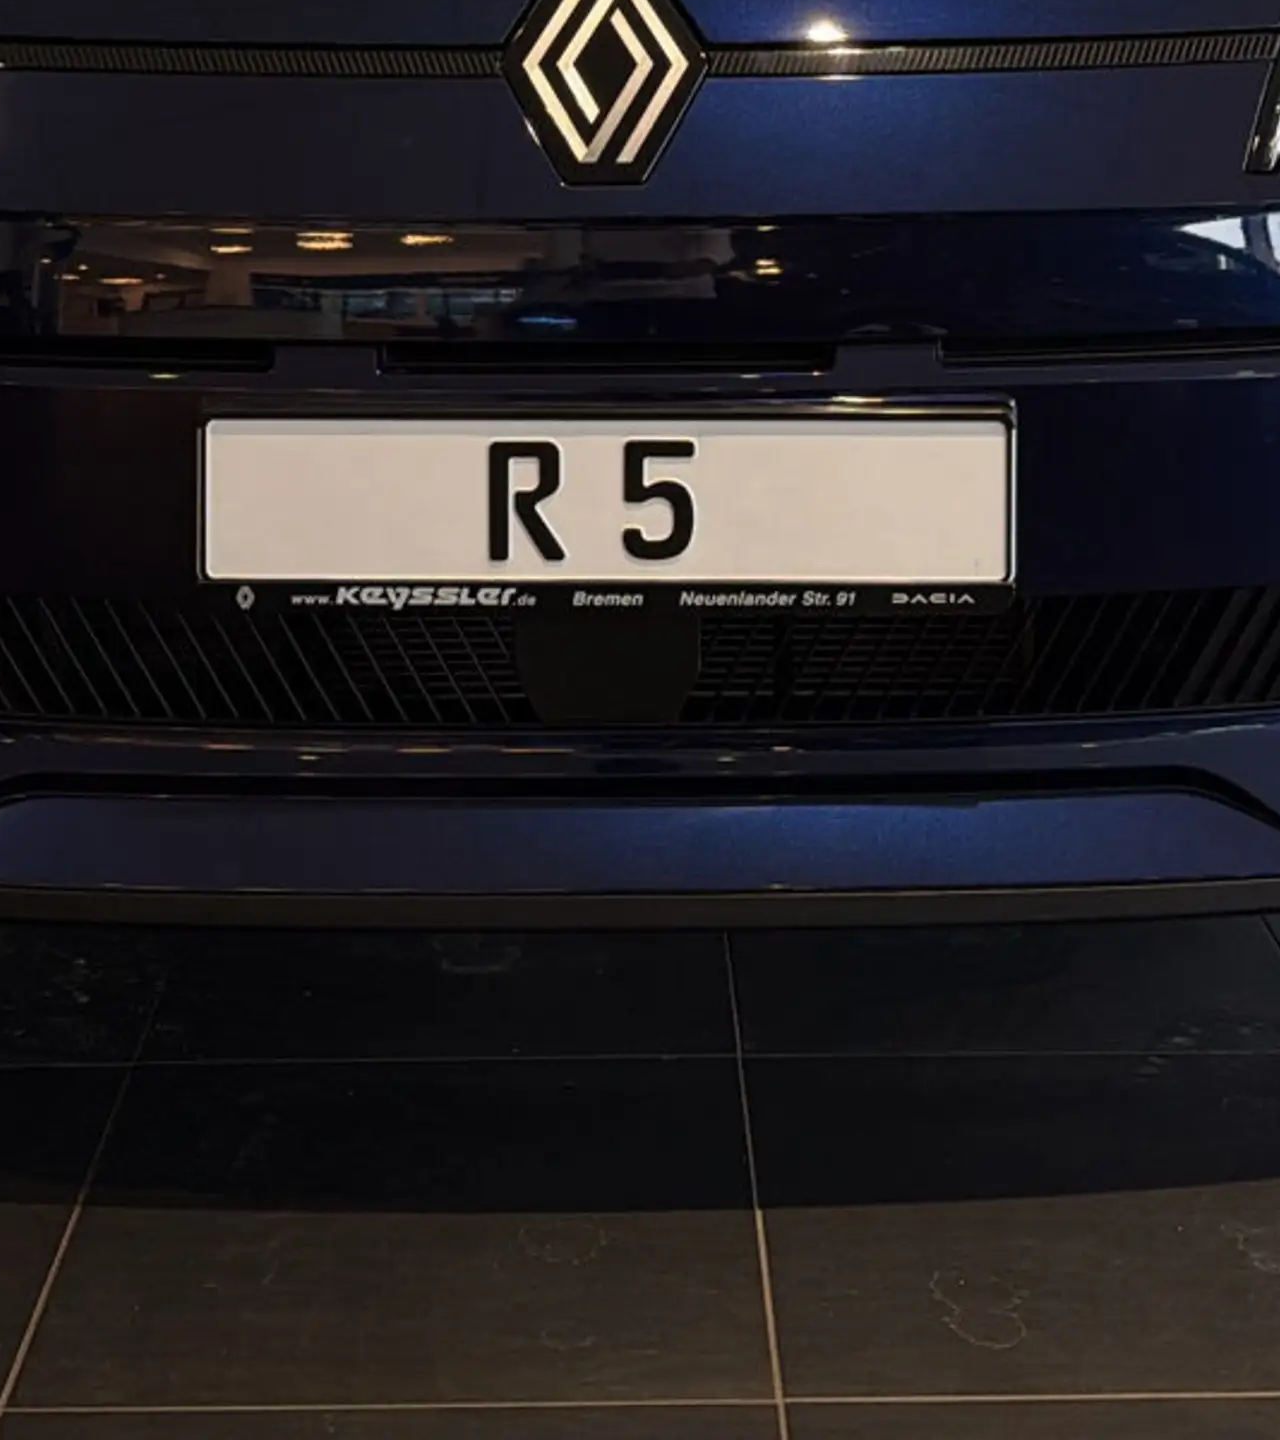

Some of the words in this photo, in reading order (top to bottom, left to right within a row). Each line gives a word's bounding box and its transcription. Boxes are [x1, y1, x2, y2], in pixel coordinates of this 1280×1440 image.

[487, 440, 567, 561] R
[622, 439, 696, 561] 5
[572, 590, 644, 607] Bremen
[801, 590, 831, 607] Str.
[836, 590, 857, 607] 91
[891, 592, 976, 605] DACIA
